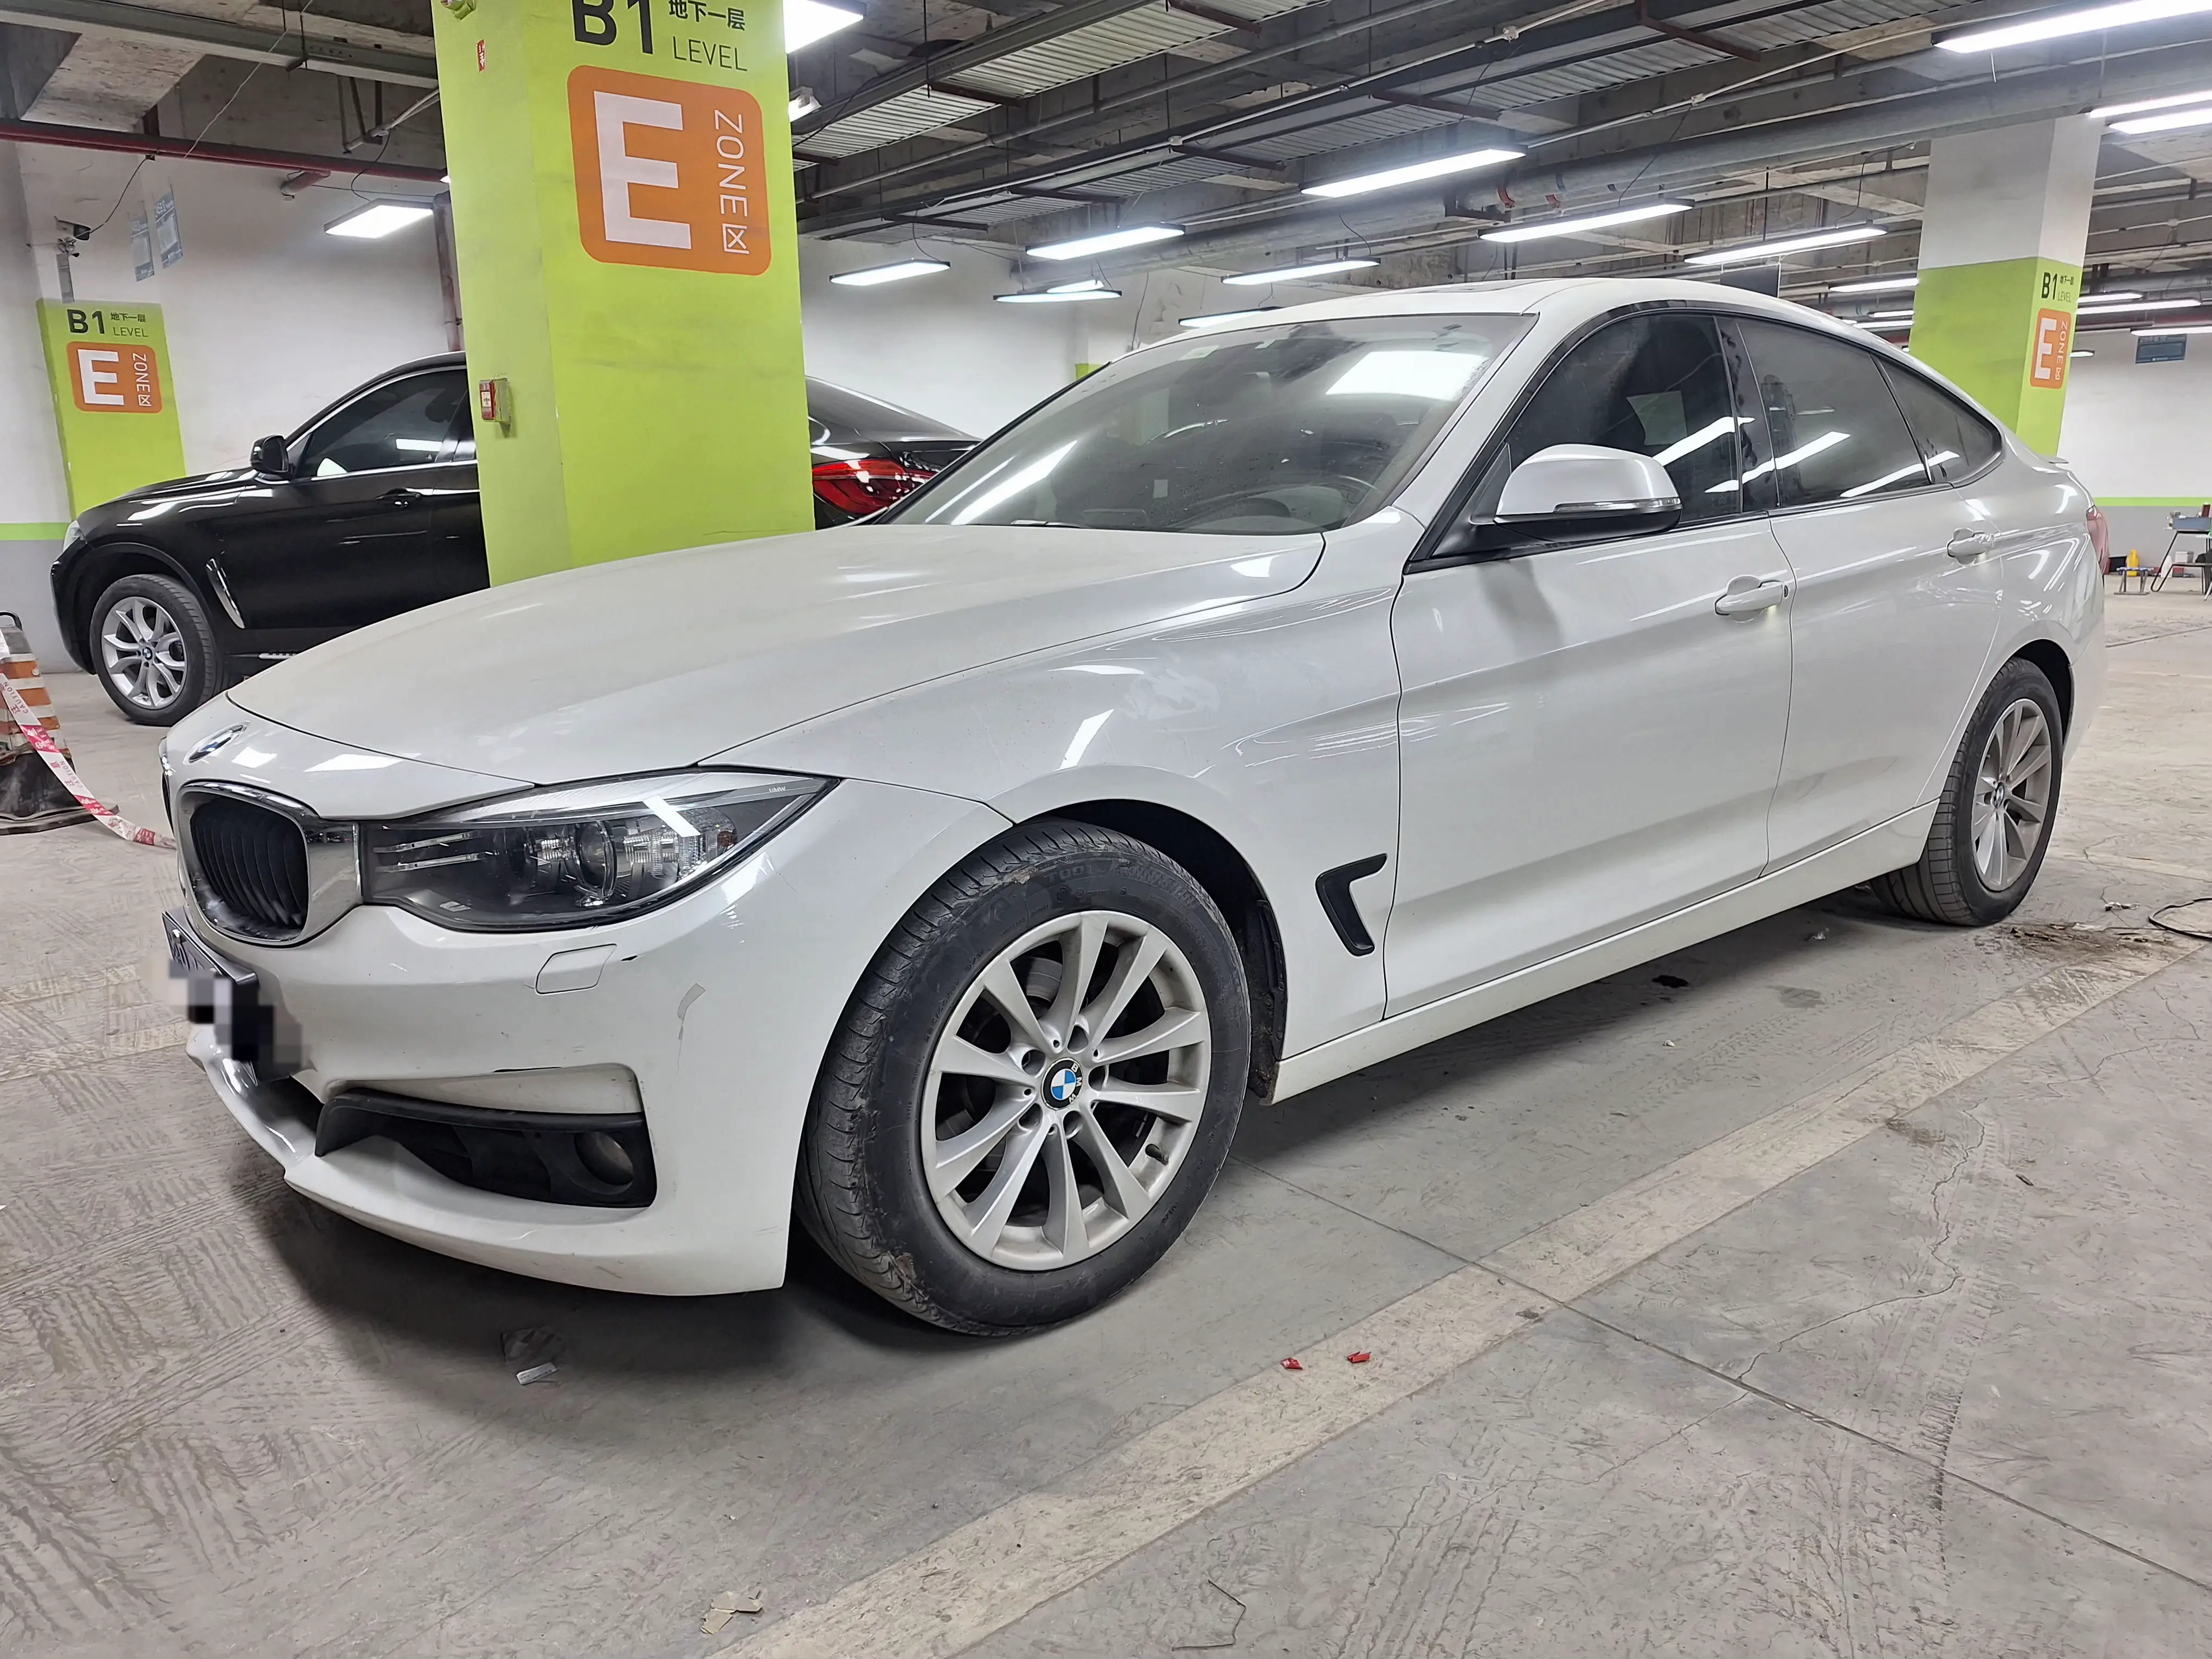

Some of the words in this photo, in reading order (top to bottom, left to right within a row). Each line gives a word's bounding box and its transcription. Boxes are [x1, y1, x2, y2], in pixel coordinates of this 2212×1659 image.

[572, 0, 654, 55] B1
[668, 0, 746, 31] 地下一层
[672, 36, 748, 72] LEVEL
[594, 91, 692, 249] E
[714, 110, 748, 217] ZONE
[722, 223, 750, 255] 区
[2041, 272, 2059, 300] B1
[66, 308, 106, 335] B1
[110, 312, 146, 323] 地下一层
[113, 326, 149, 338] LEVEL
[2035, 318, 2057, 380] E
[78, 349, 125, 406] E
[132, 352, 151, 393] ZONE
[3, 681, 29, 714] CAUTION
[36, 727, 56, 750] SAFE
[1068, 1062, 1083, 1104] BMW
